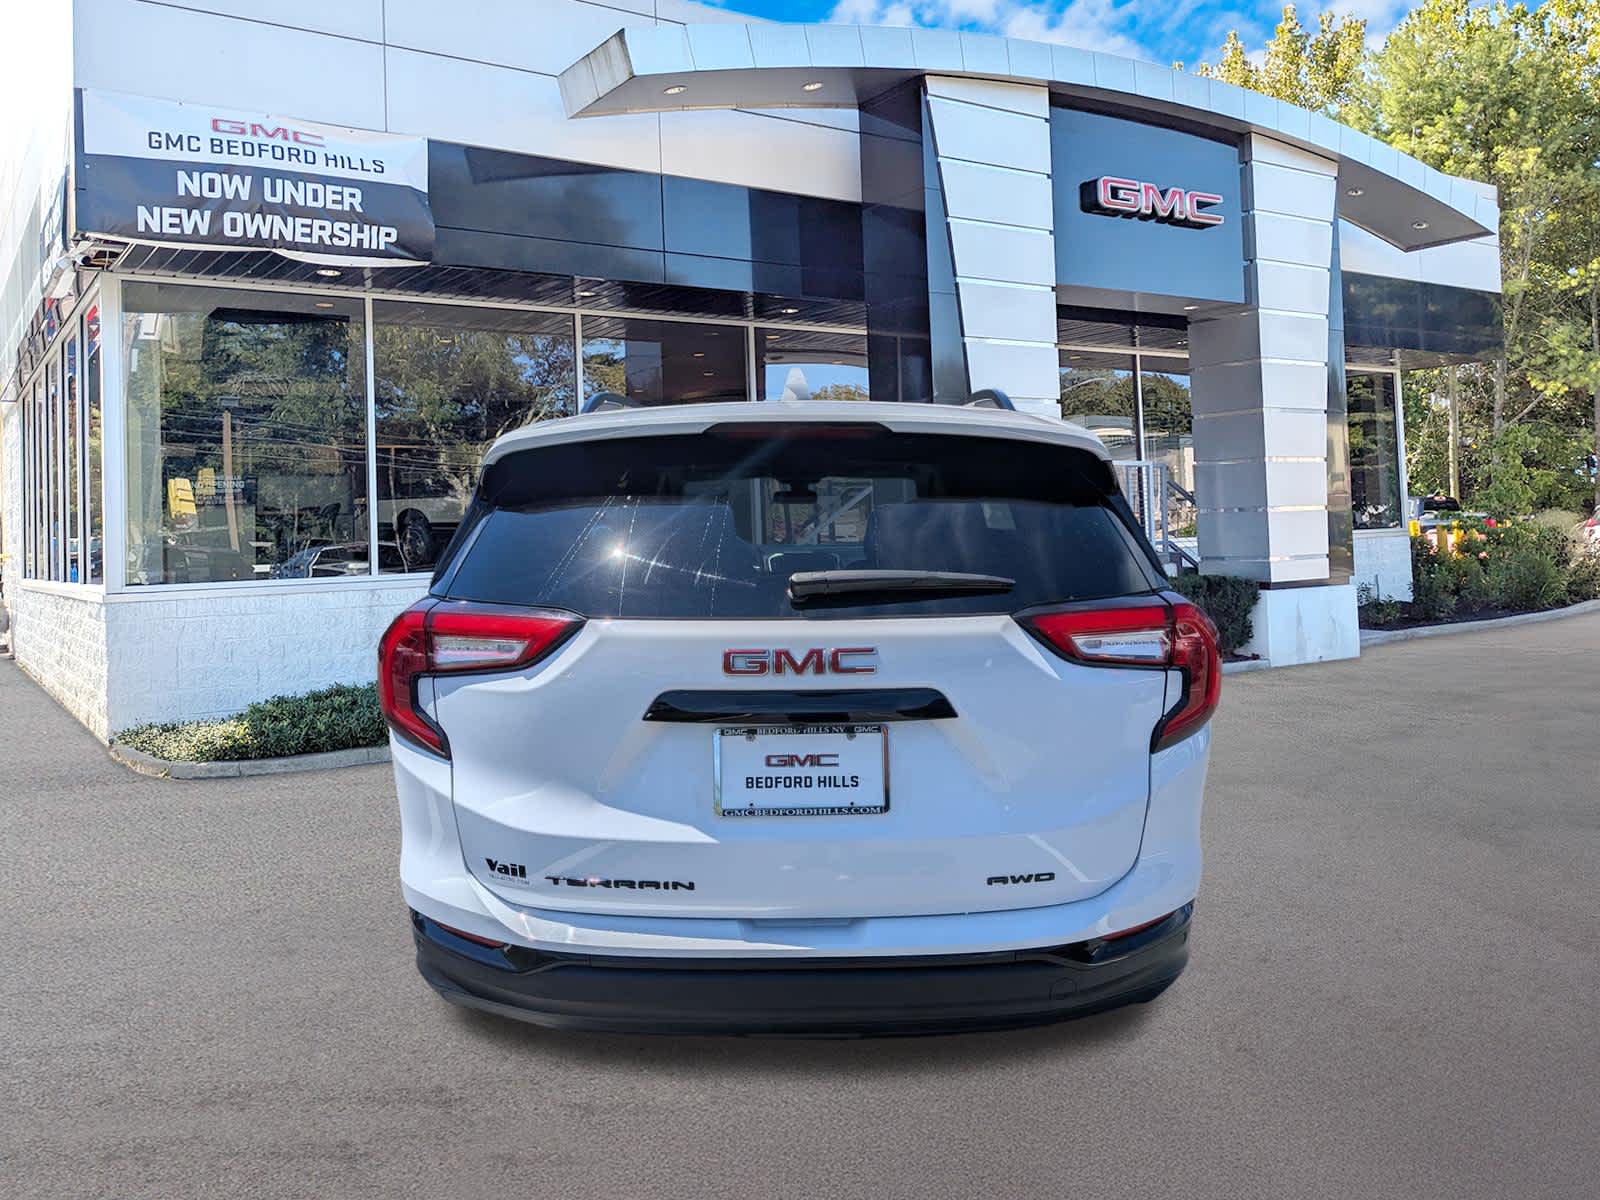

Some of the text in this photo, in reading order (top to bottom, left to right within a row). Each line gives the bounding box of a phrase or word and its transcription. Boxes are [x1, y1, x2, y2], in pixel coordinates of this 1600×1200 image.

[211, 118, 326, 148] GMC
[148, 131, 385, 174] GMC BEDFORD HILLS
[177, 170, 364, 213] NOW UNDER
[1098, 175, 1225, 225] GMC
[136, 205, 398, 250] NEW OWNERSHIP
[723, 648, 877, 676] GMC
[724, 728, 748, 736] GMC
[853, 725, 878, 734] GMC
[765, 754, 839, 767] GMC
[745, 775, 860, 789] BEDFORD HILLS
[723, 806, 881, 817] GMCBEDFORDHILLS.COM
[485, 857, 527, 879] Vail
[986, 872, 1056, 886] AWD
[545, 875, 696, 891] TERRAIN
